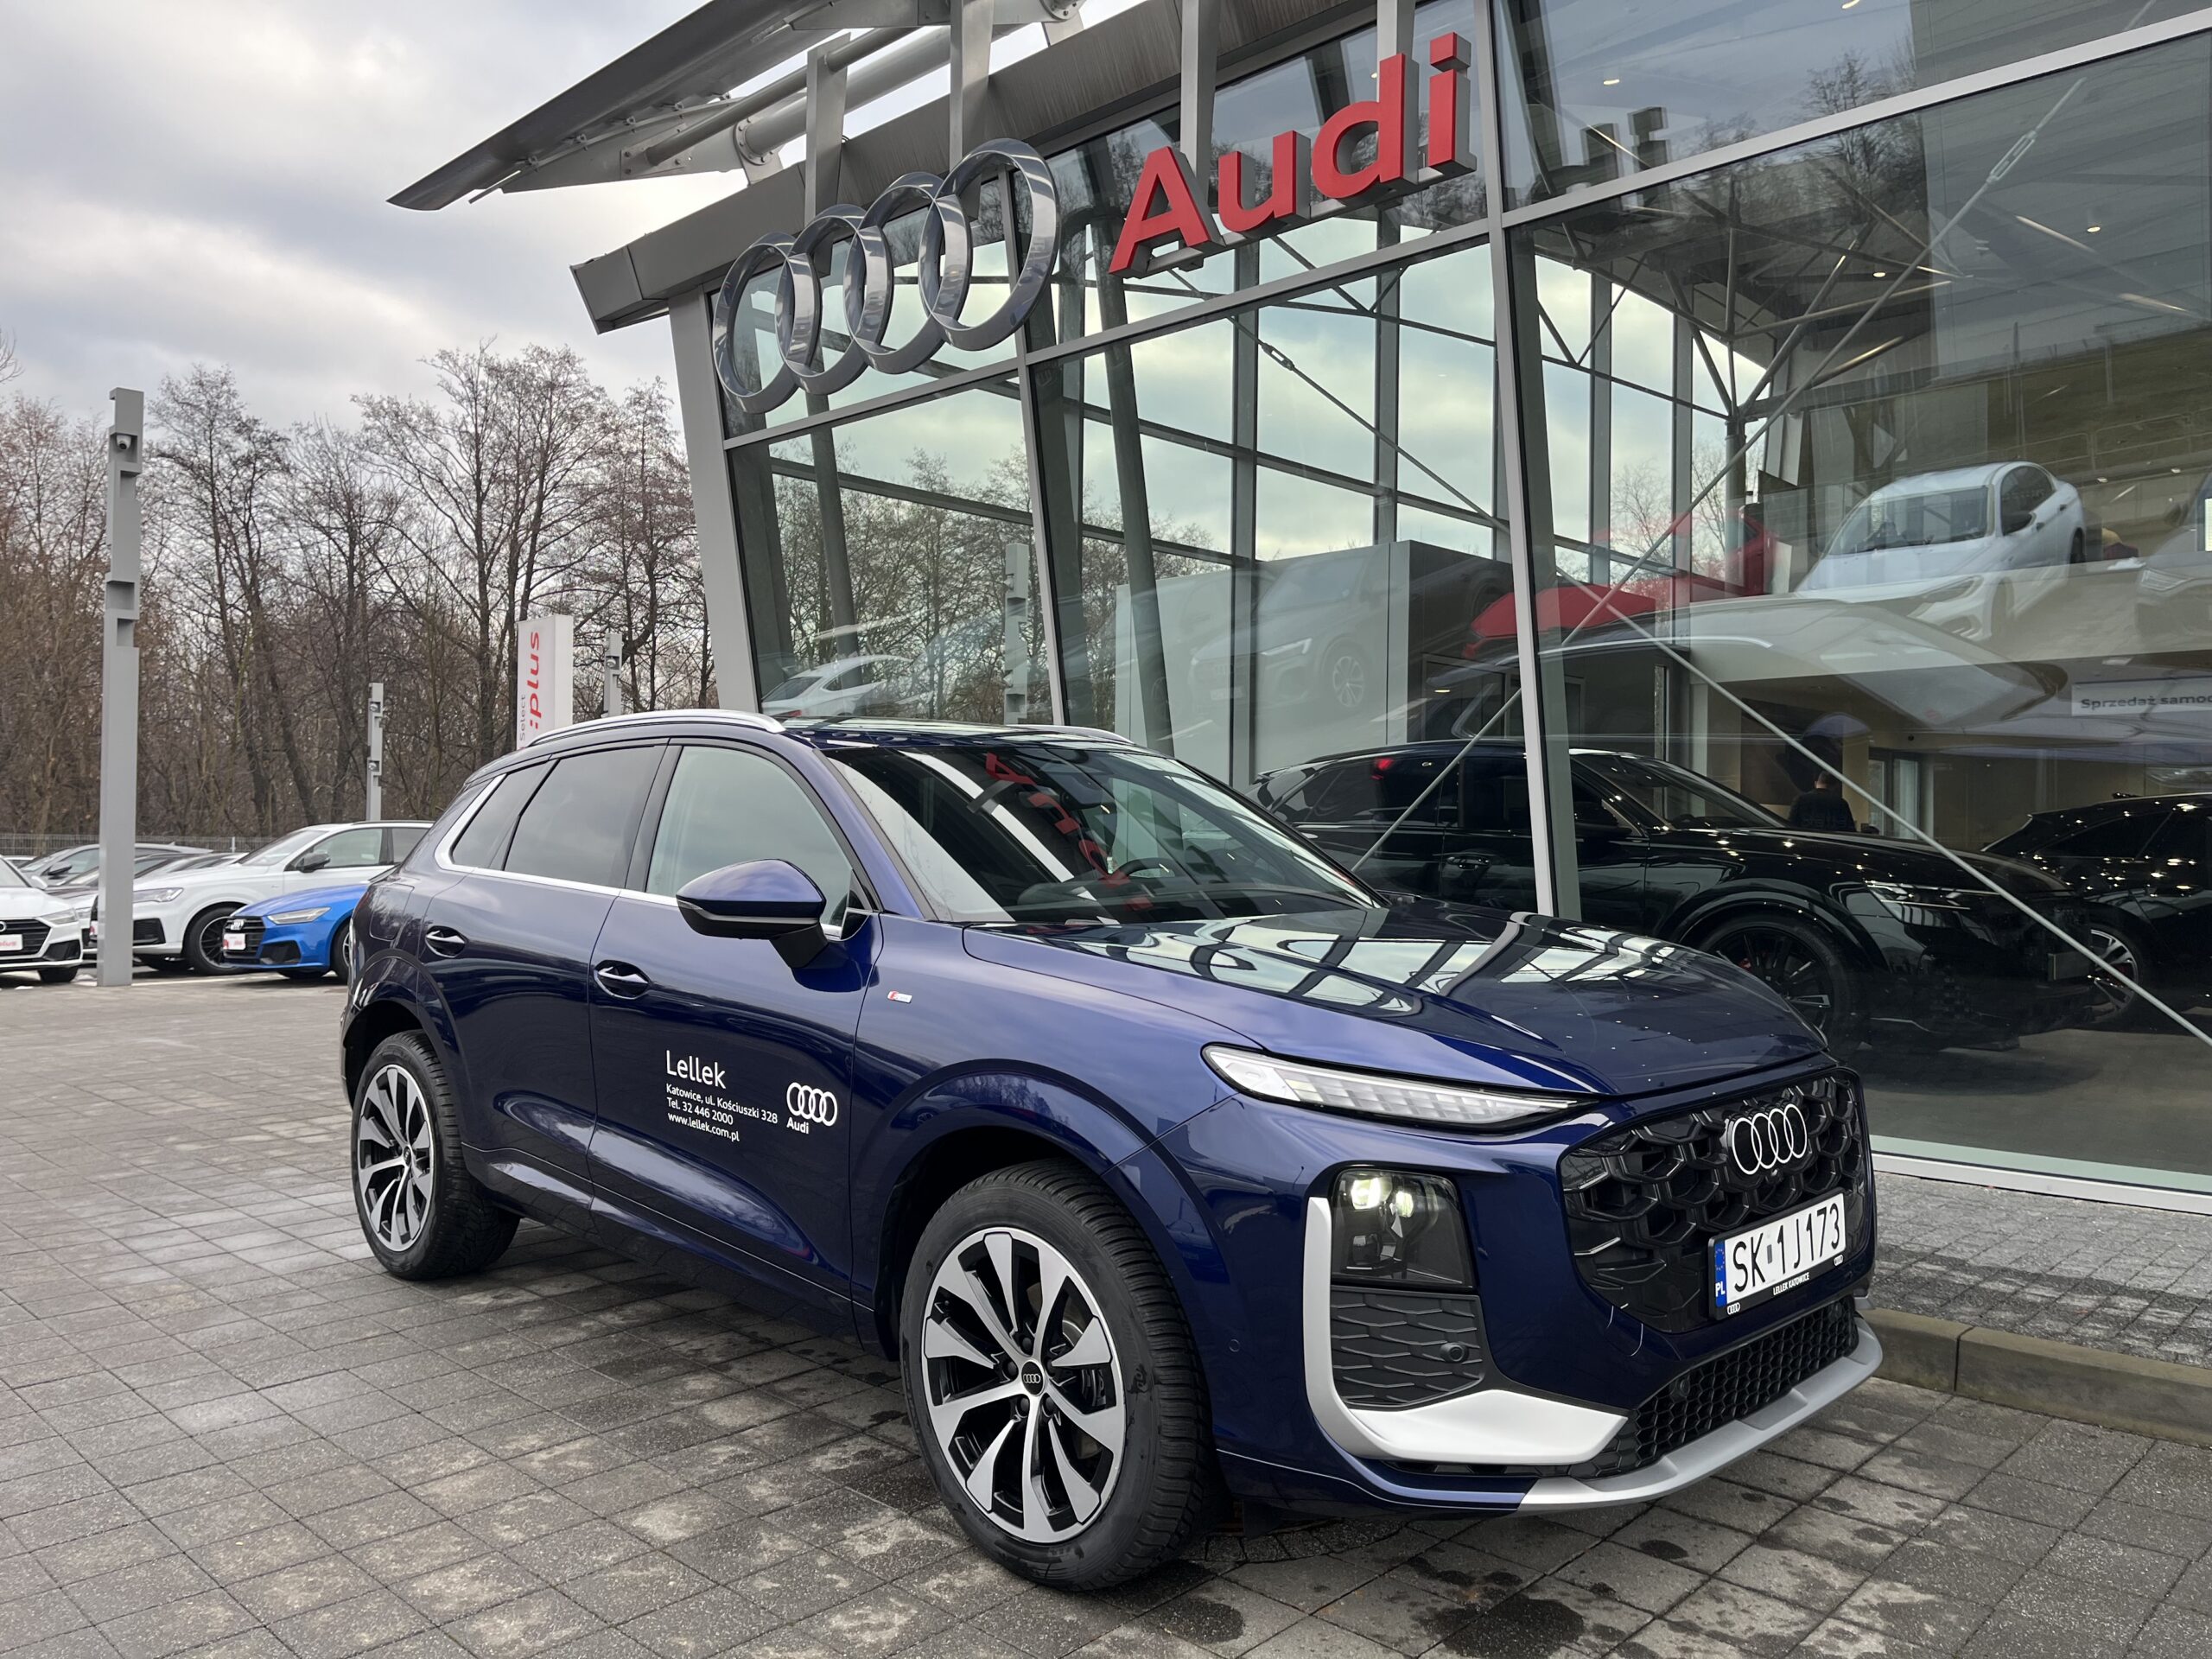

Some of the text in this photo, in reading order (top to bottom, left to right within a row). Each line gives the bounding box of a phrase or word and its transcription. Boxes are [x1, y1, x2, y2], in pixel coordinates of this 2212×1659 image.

[1109, 32, 1467, 274] Audi
[666, 1050, 726, 1089] Lellek
[666, 1083, 778, 1124] Katowice, ul. Kościuszki 328
[666, 1096, 734, 1125] Tel. 32 446 2000
[667, 1113, 740, 1141] www.lellek.com.pl
[786, 1116, 809, 1134] Audi
[1732, 1203, 1840, 1292] SK 1J173
[1715, 1281, 1726, 1297] PL
